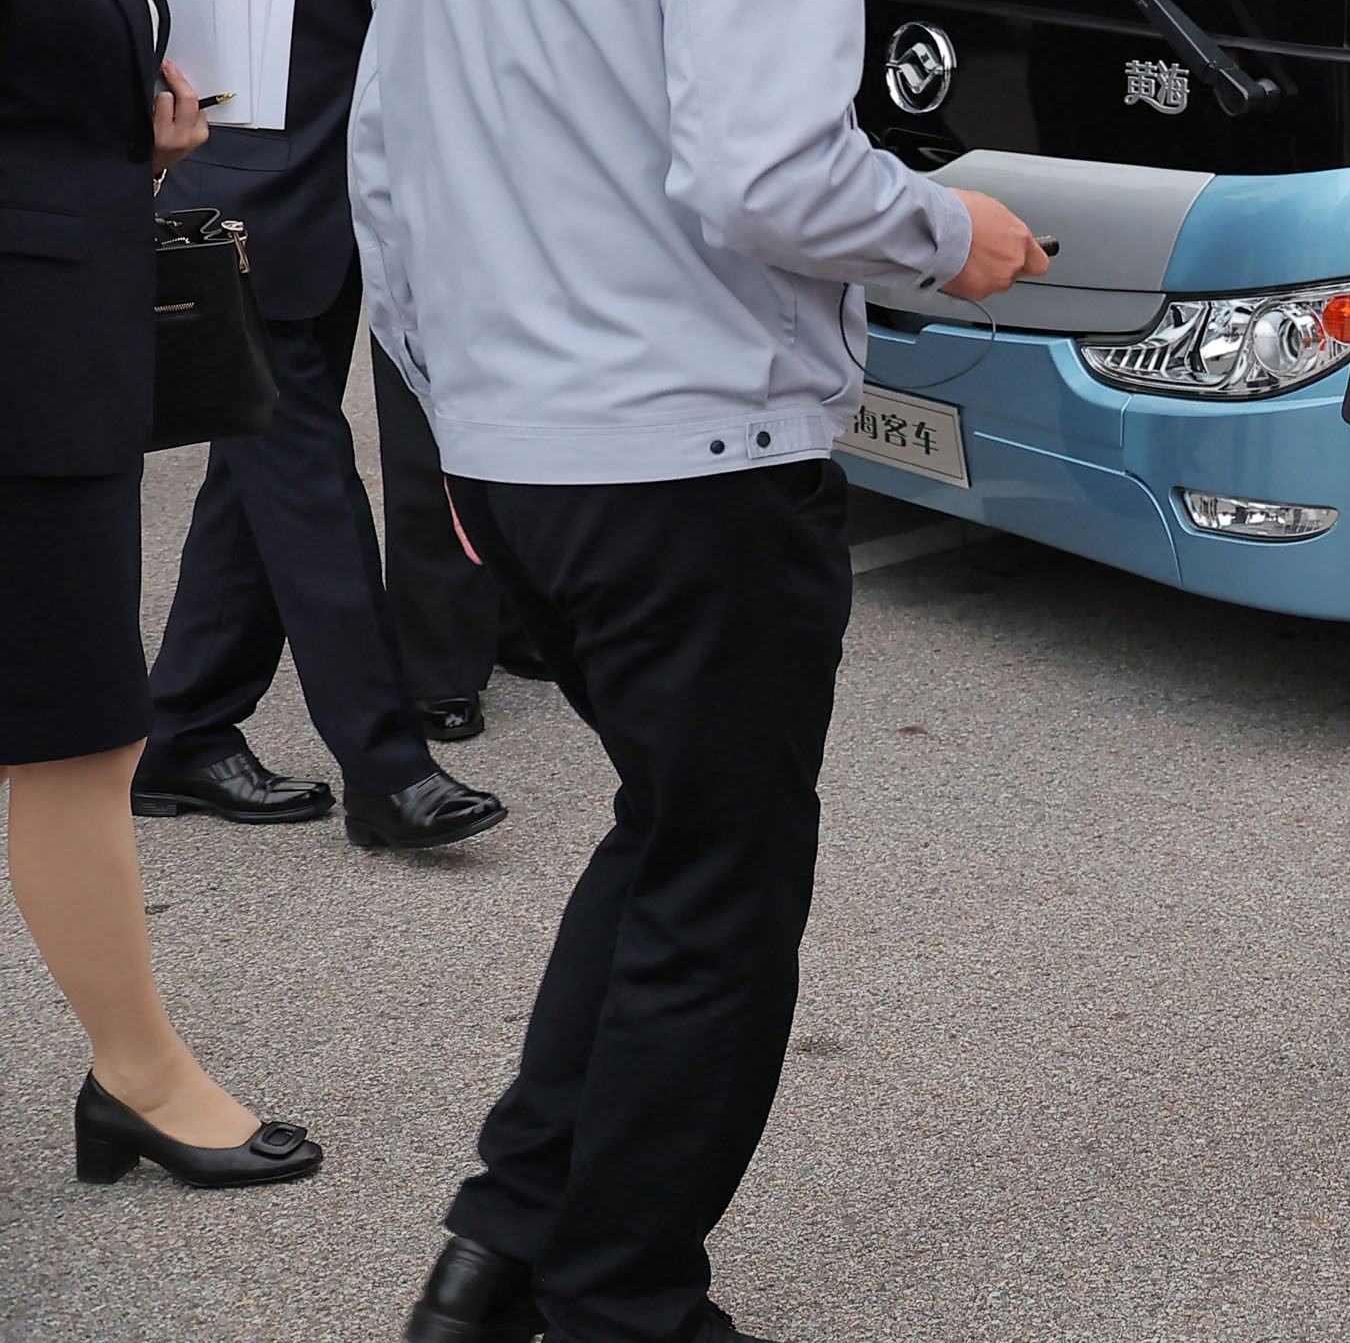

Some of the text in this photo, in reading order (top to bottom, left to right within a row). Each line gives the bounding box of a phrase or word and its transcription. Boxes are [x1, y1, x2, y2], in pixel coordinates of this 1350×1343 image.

[1124, 59, 1190, 115] 黄海
[847, 405, 939, 455] 海客车
